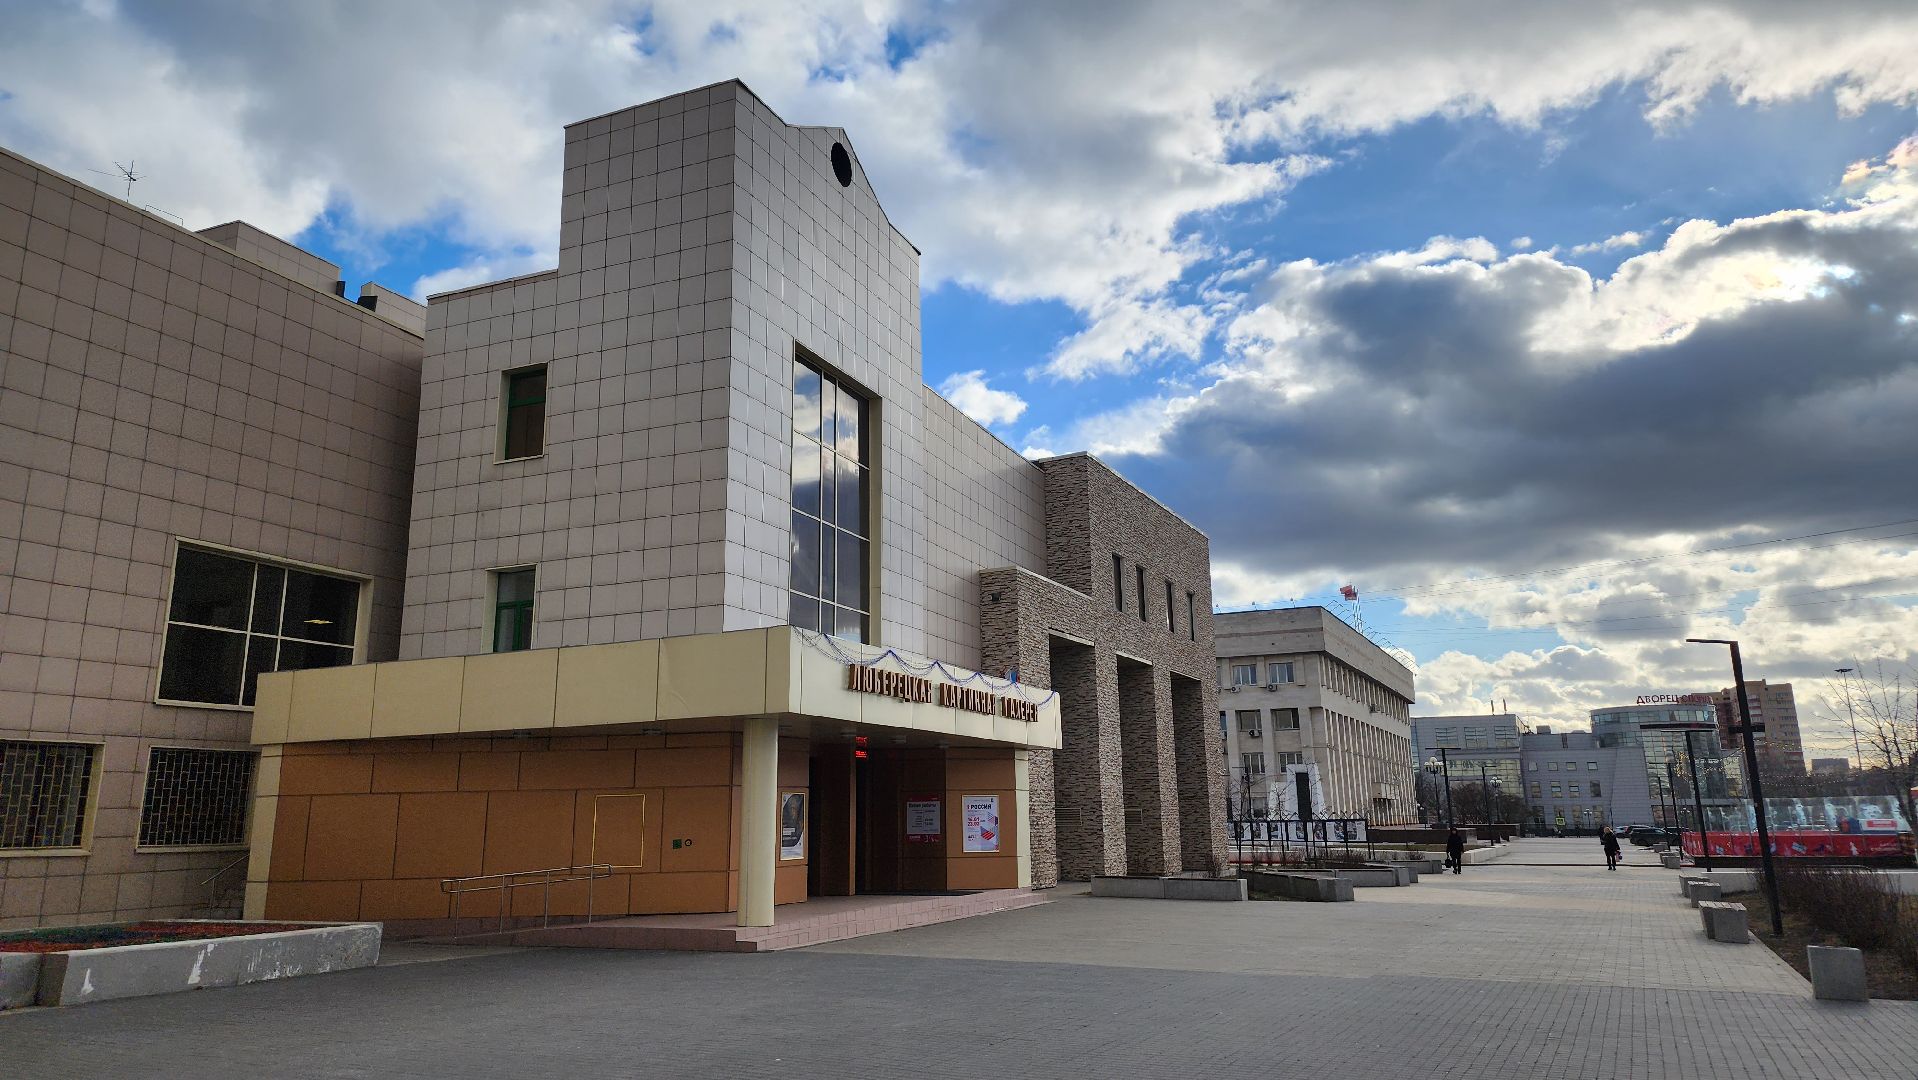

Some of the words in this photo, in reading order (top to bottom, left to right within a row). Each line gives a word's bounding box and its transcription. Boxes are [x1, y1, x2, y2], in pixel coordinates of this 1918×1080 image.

[849, 664, 933, 704] ЛЮБЕРЕЦКАЯ
[940, 683, 997, 716] КАРТИННАЯ
[1001, 697, 1039, 722] ГАЛЕРЕЯ
[1636, 695, 1680, 705] ДВОРЕЦ
